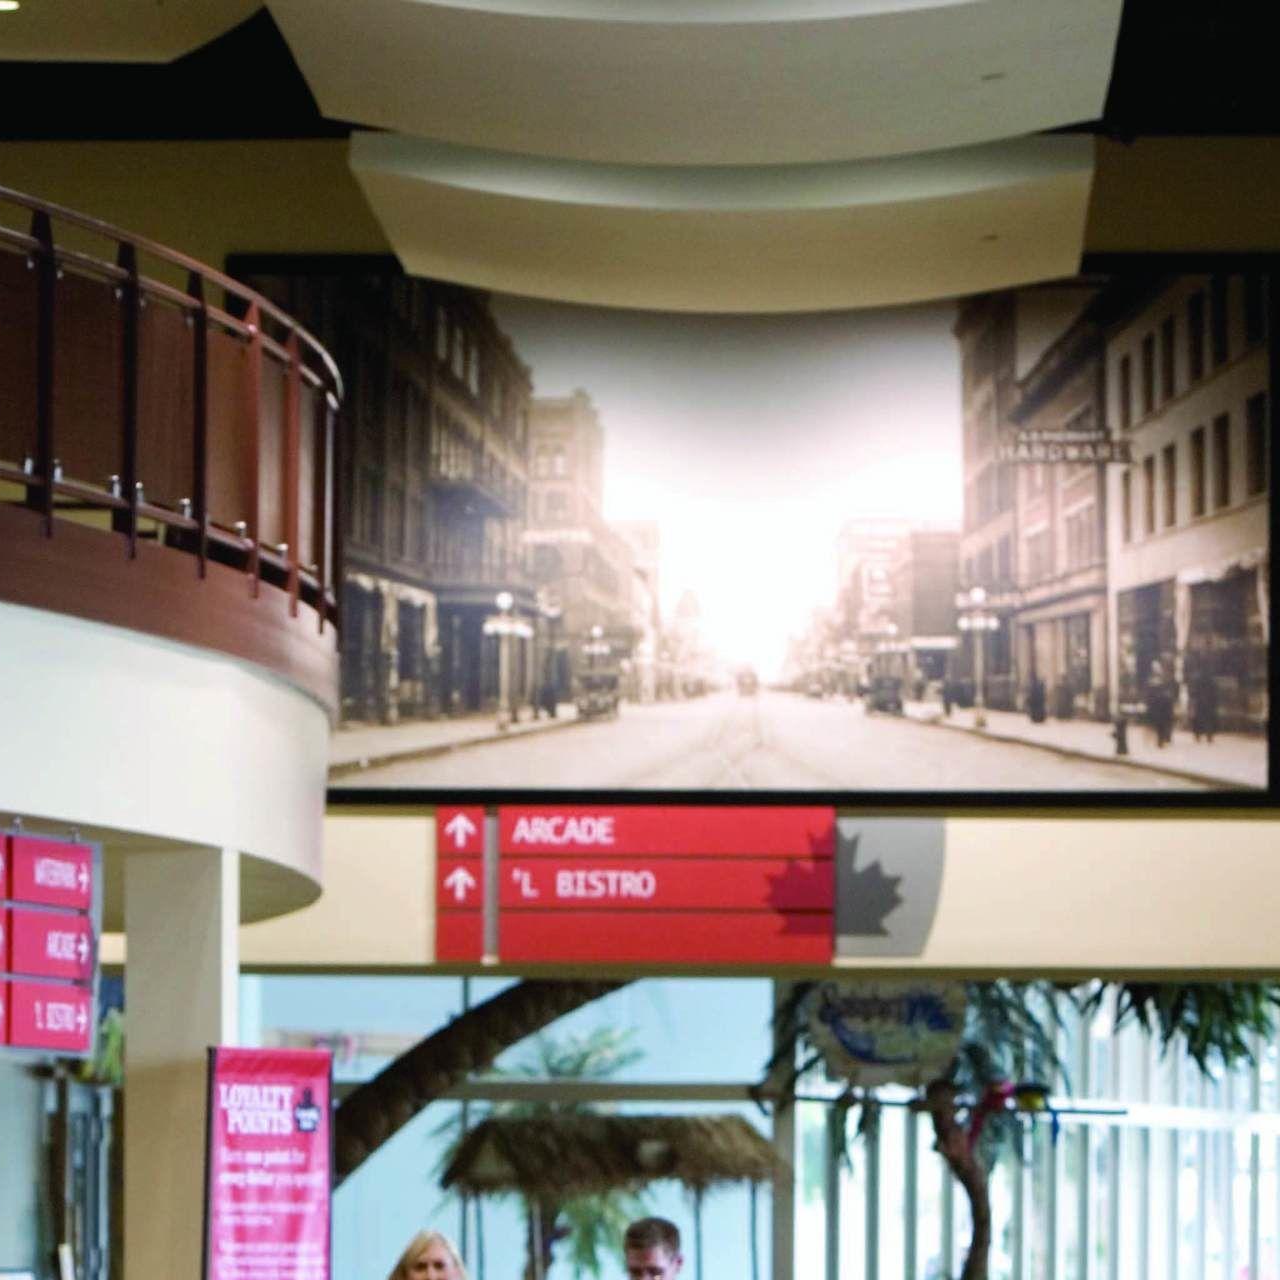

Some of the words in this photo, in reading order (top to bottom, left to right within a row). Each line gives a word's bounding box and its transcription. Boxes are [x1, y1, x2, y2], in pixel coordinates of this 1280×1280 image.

[511, 815, 617, 846] ARCADE
[556, 869, 657, 899] BISTRO
[219, 1083, 295, 1109] LOYALTY
[227, 1108, 294, 1134] POINTS
